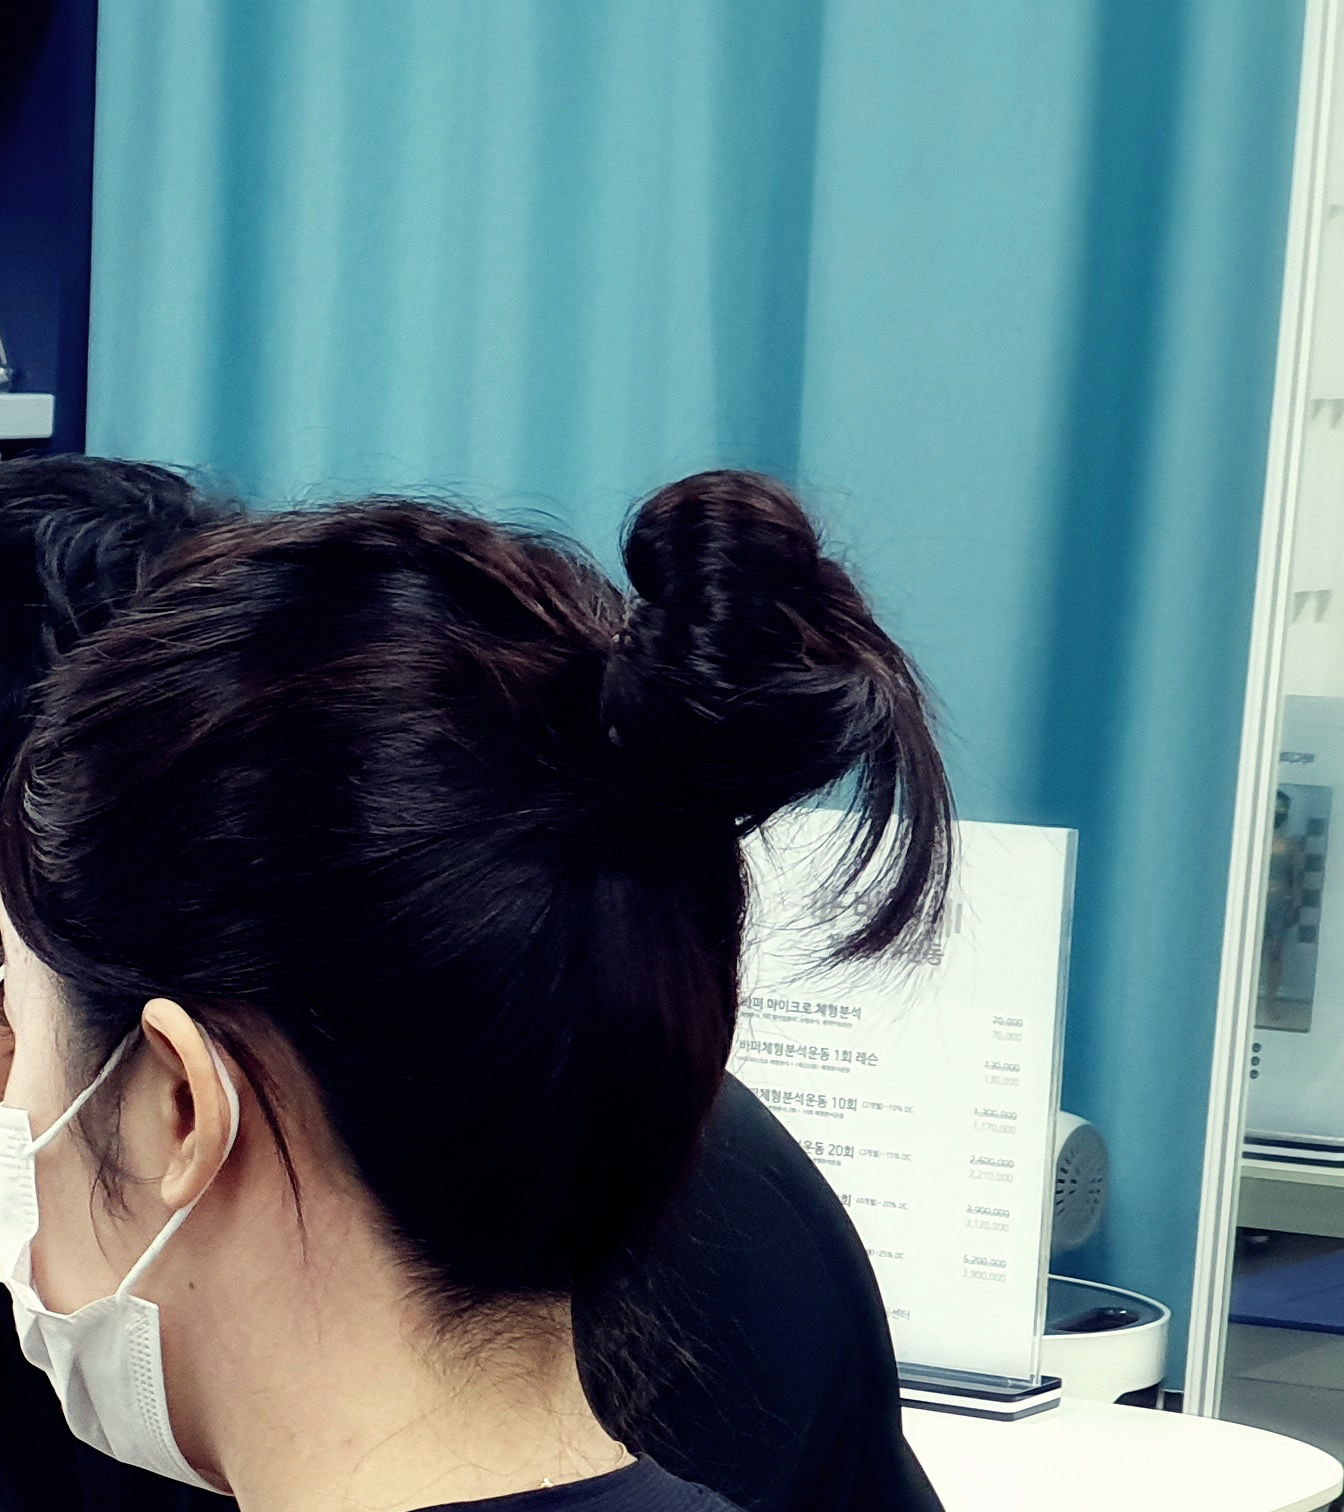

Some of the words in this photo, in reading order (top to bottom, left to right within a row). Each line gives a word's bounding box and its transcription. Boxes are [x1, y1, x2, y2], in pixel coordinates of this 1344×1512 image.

[831, 1096, 858, 1112] 10회
[799, 1139, 825, 1157] 운동
[828, 1143, 855, 1159] 20회
[887, 1306, 911, 1321] 센터
